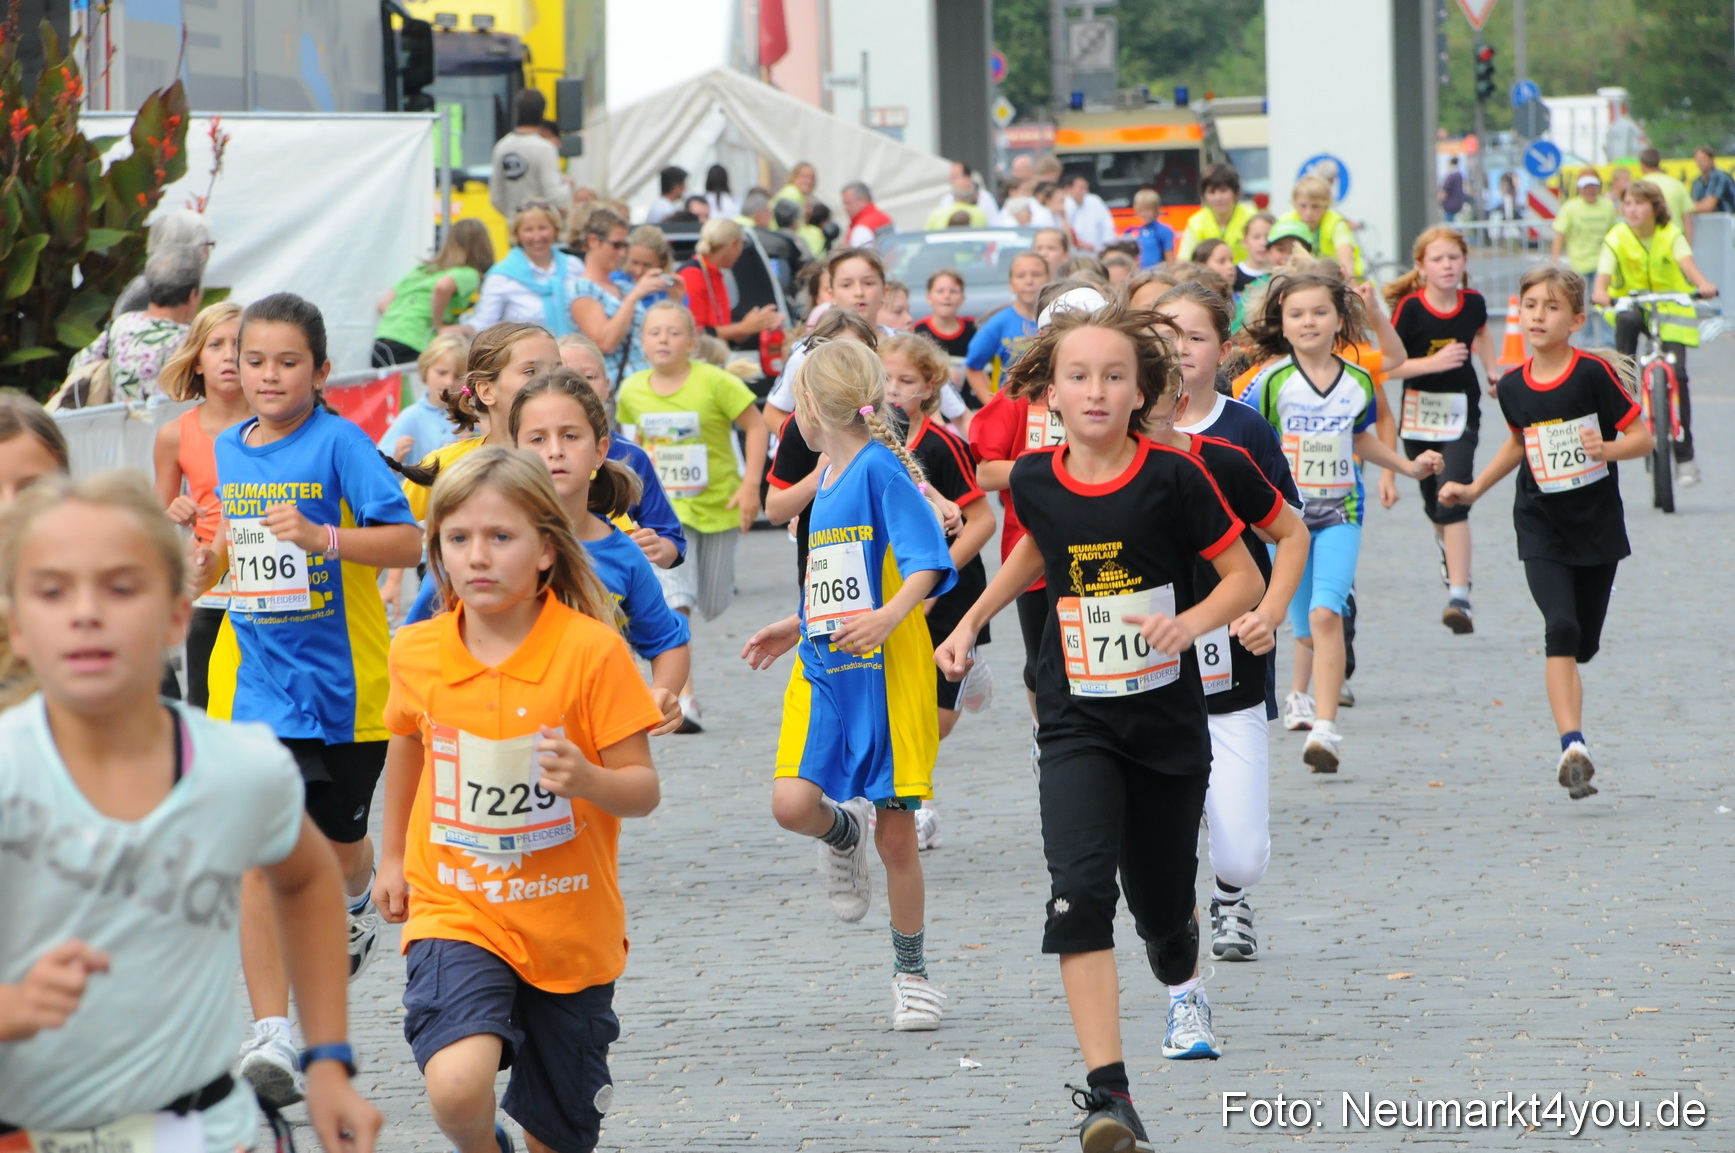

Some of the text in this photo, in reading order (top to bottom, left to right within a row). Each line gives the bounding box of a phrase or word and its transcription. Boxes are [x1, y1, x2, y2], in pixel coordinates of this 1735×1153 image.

[1422, 411, 1460, 426] 7217
[1302, 441, 1333, 453] Celina
[1547, 447, 1587, 470] 726
[660, 466, 701, 481] 7190
[1303, 460, 1349, 477] 7119
[232, 527, 265, 545] Celine
[808, 525, 873, 550] UMARKTER
[1068, 541, 1123, 554] NEUMARKTER
[1073, 549, 1119, 562] STADTLAUF
[237, 554, 296, 582] 7196
[811, 556, 828, 573] Anna
[811, 576, 860, 607] 7068
[1085, 576, 1143, 592] BAMBINILAUF
[1087, 605, 1111, 624] Ida
[1066, 634, 1080, 649] K5
[1093, 632, 1152, 663] 710
[1139, 665, 1179, 685] PFLEIDERER
[1203, 679, 1230, 690] IDERER
[466, 781, 557, 817] 7229
[516, 824, 573, 844] PFLEIDERER
[506, 872, 590, 902] Reisen
